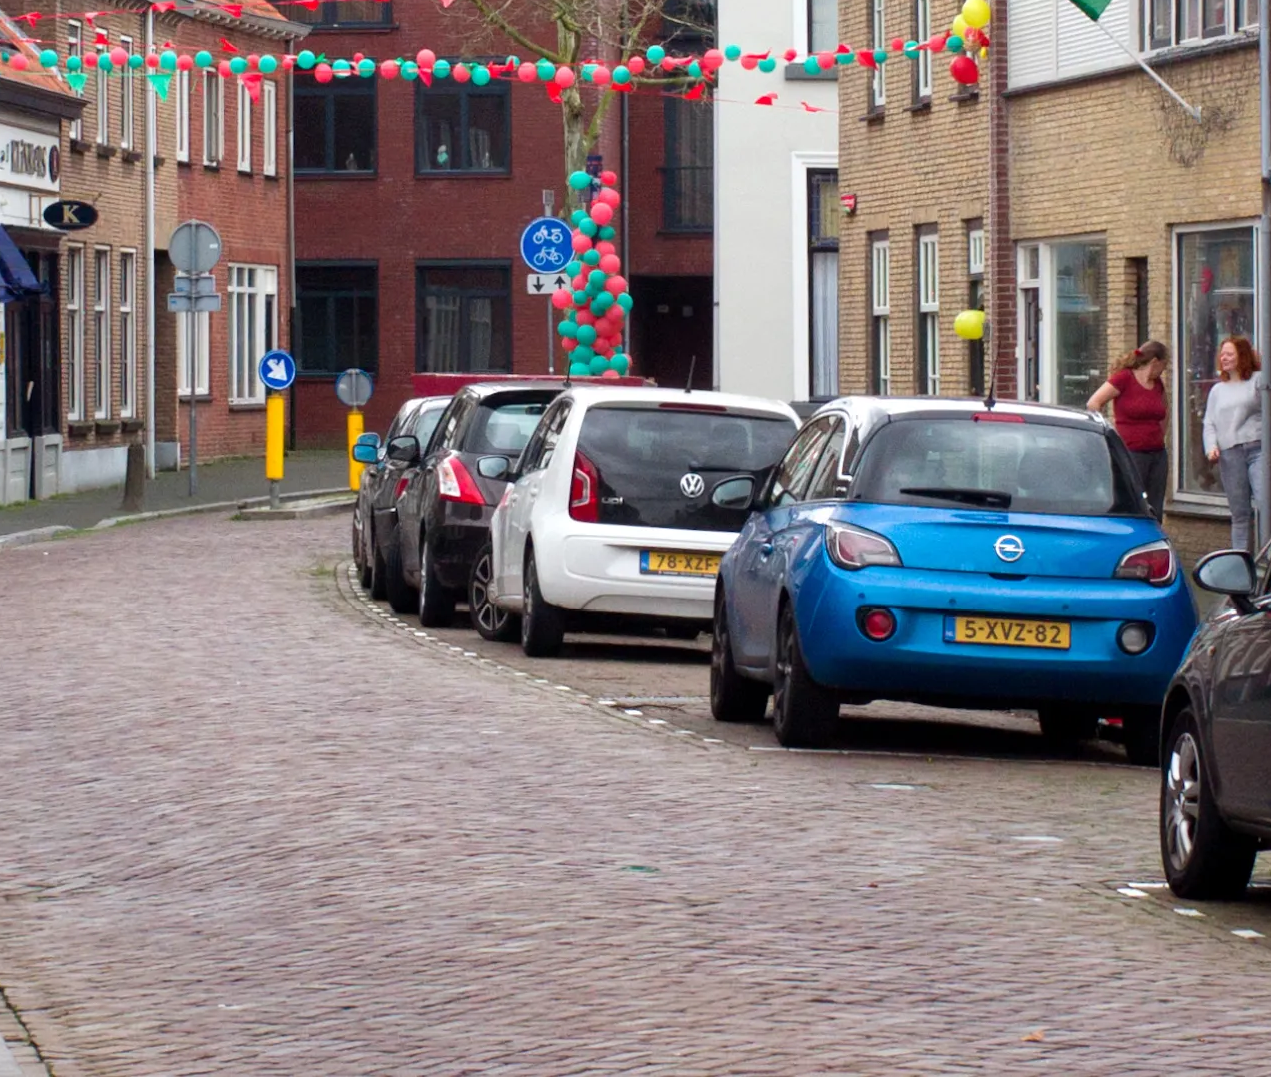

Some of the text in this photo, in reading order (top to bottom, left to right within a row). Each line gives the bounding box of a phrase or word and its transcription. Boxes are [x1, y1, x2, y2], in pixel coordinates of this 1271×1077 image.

[62, 204, 81, 223] K
[657, 554, 718, 571] 78-XZF-
[964, 620, 1062, 644] 5-XVZ-82
